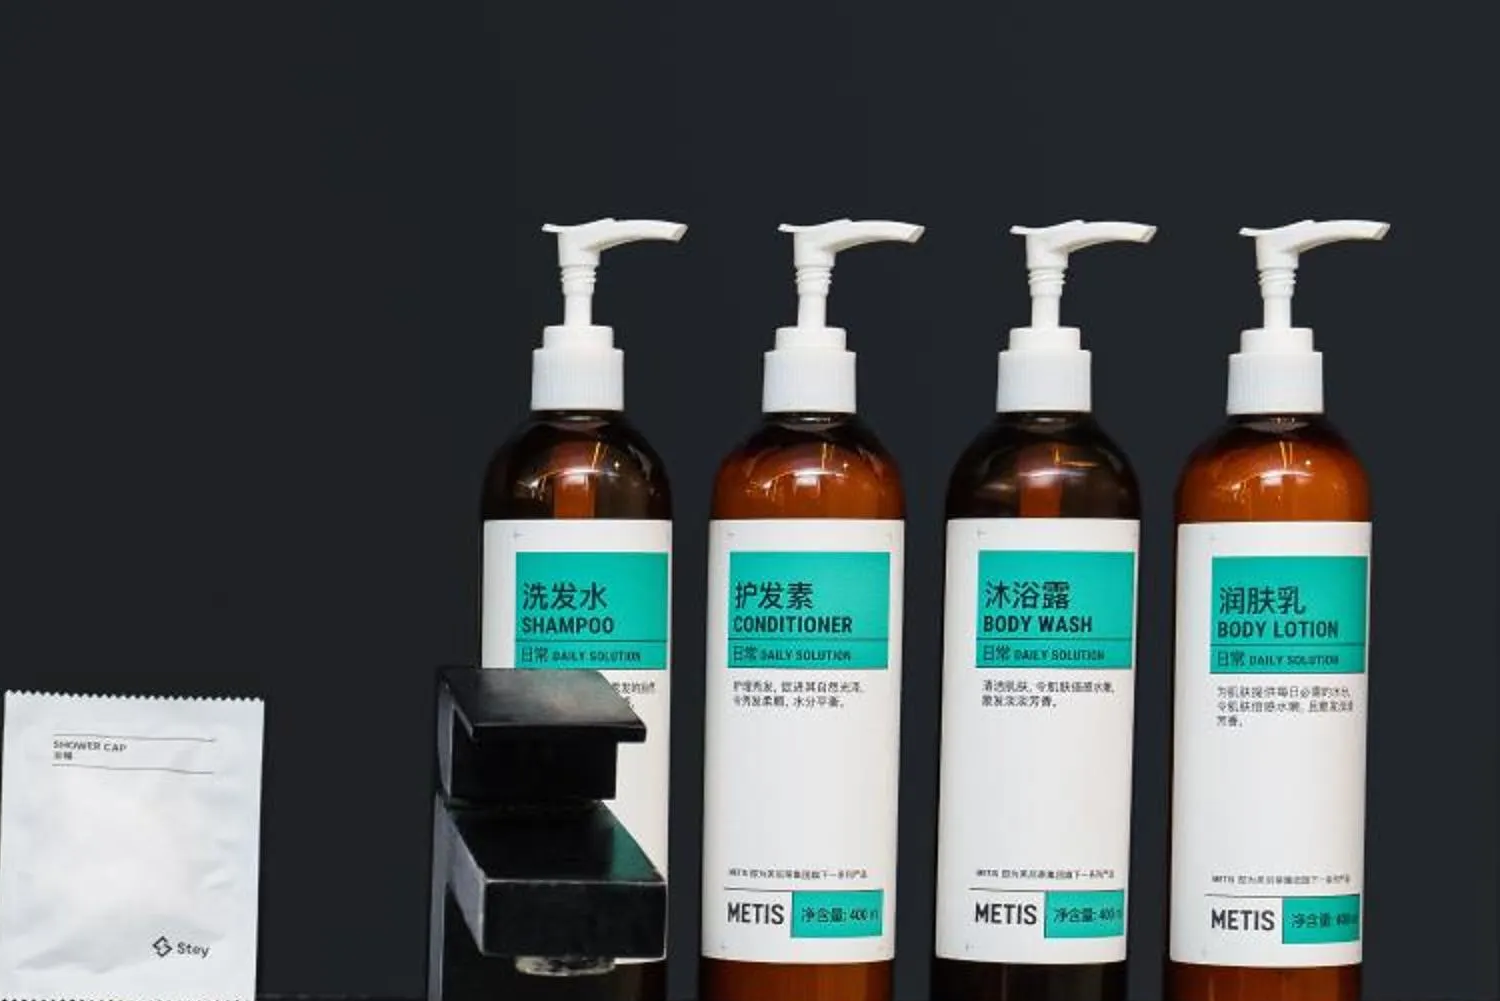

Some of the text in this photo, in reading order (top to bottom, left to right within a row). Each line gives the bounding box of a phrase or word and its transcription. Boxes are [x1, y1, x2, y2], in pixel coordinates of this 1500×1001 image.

[522, 581, 608, 611] 洗发水
[734, 581, 814, 610] 护发素
[985, 580, 1070, 610] 沐浴露
[1219, 586, 1307, 615] 润肤乳
[522, 616, 615, 635] SHAMPOO
[733, 615, 853, 634] CONDITIONER
[983, 615, 1093, 633] BODY WASH
[1217, 620, 1339, 639] BODY LOTION
[521, 646, 642, 663] 日常 DAILY SOLUTION
[733, 645, 852, 662] 日常 DAILY SOLUTION
[983, 645, 1106, 662] 日常 DAILY SOLUTION
[1217, 650, 1340, 667] 日常 DAILY SOLUTION
[53, 740, 128, 753] SHOWER CAP
[727, 902, 785, 926] METIS
[975, 901, 1038, 926] METIS
[1211, 908, 1276, 932] METIS
